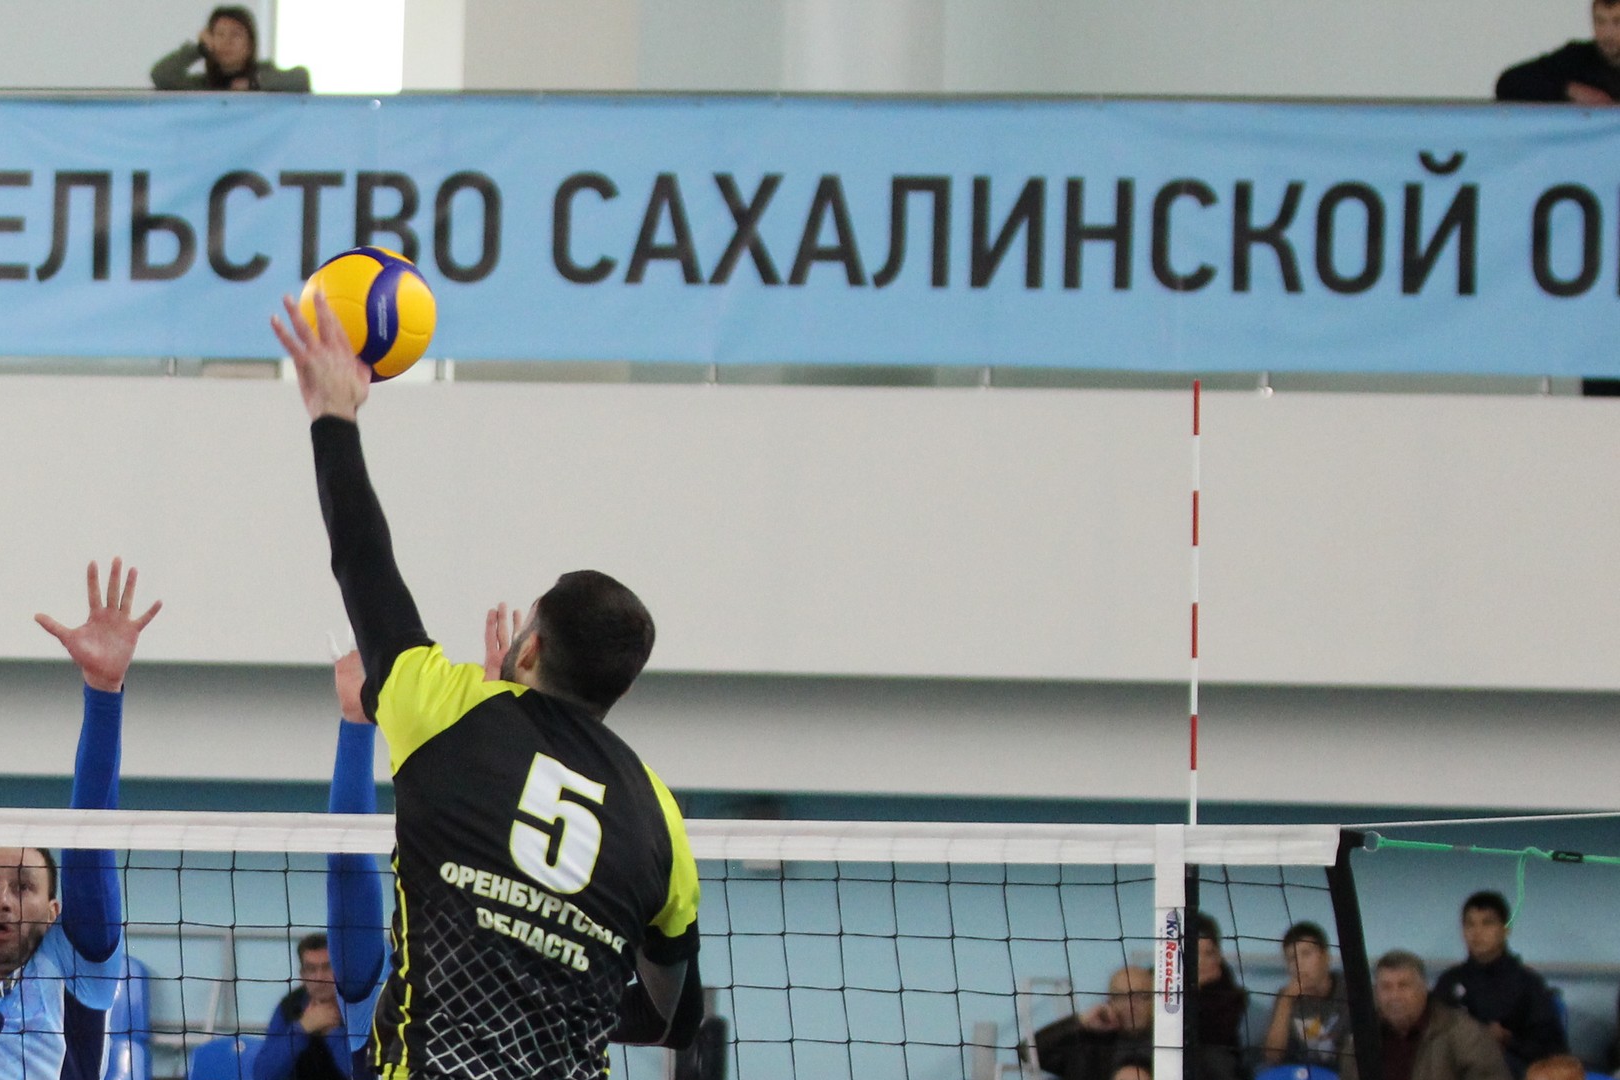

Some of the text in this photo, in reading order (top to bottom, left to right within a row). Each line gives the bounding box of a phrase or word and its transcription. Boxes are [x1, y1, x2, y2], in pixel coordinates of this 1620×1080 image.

[551, 150, 1479, 297] САХАЛИНСКОЙ
[1531, 181, 1620, 298] О
[509, 751, 607, 895] 5
[476, 906, 590, 972] ОБЛАСТЬ
